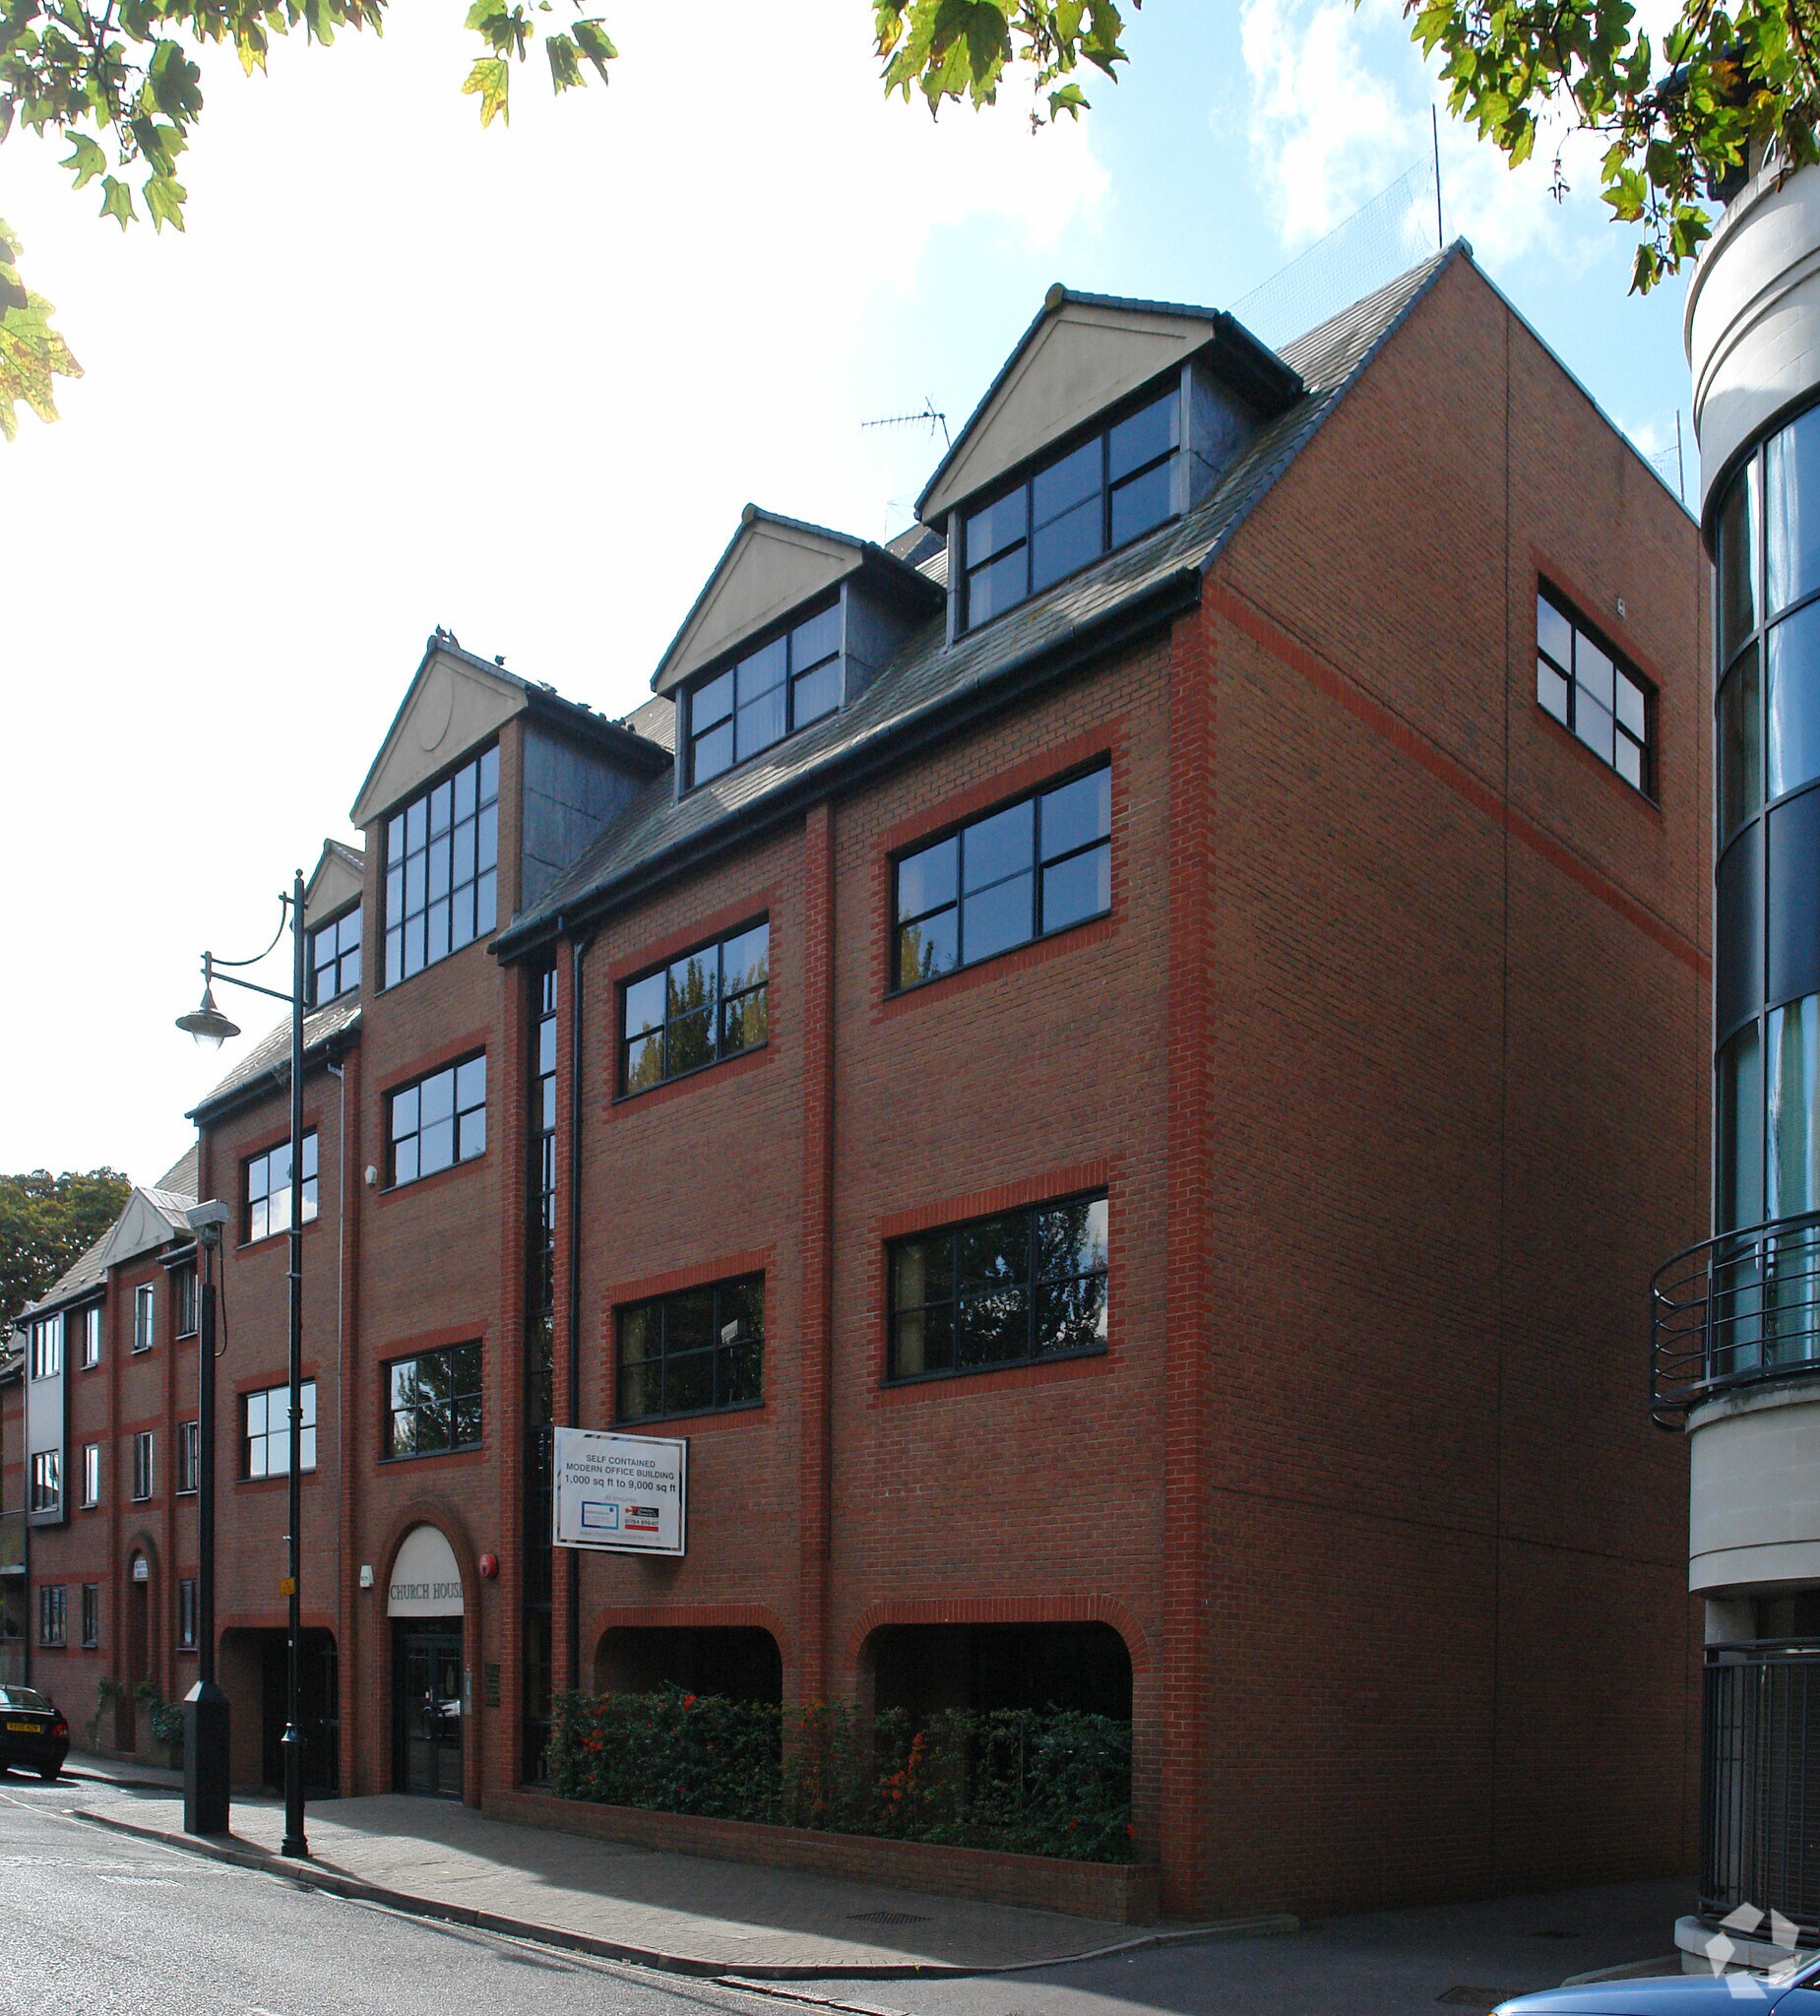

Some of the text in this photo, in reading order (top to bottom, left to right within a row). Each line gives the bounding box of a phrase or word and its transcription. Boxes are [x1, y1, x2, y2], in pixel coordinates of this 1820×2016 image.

[587, 1454, 656, 1468] SELF CONTAINED
[566, 1463, 674, 1480] MODERN OFFICE BUILDING
[565, 1475, 676, 1493] 1,000 sq ft to 9,000 sq ft
[390, 1583, 429, 1600] CHURCH
